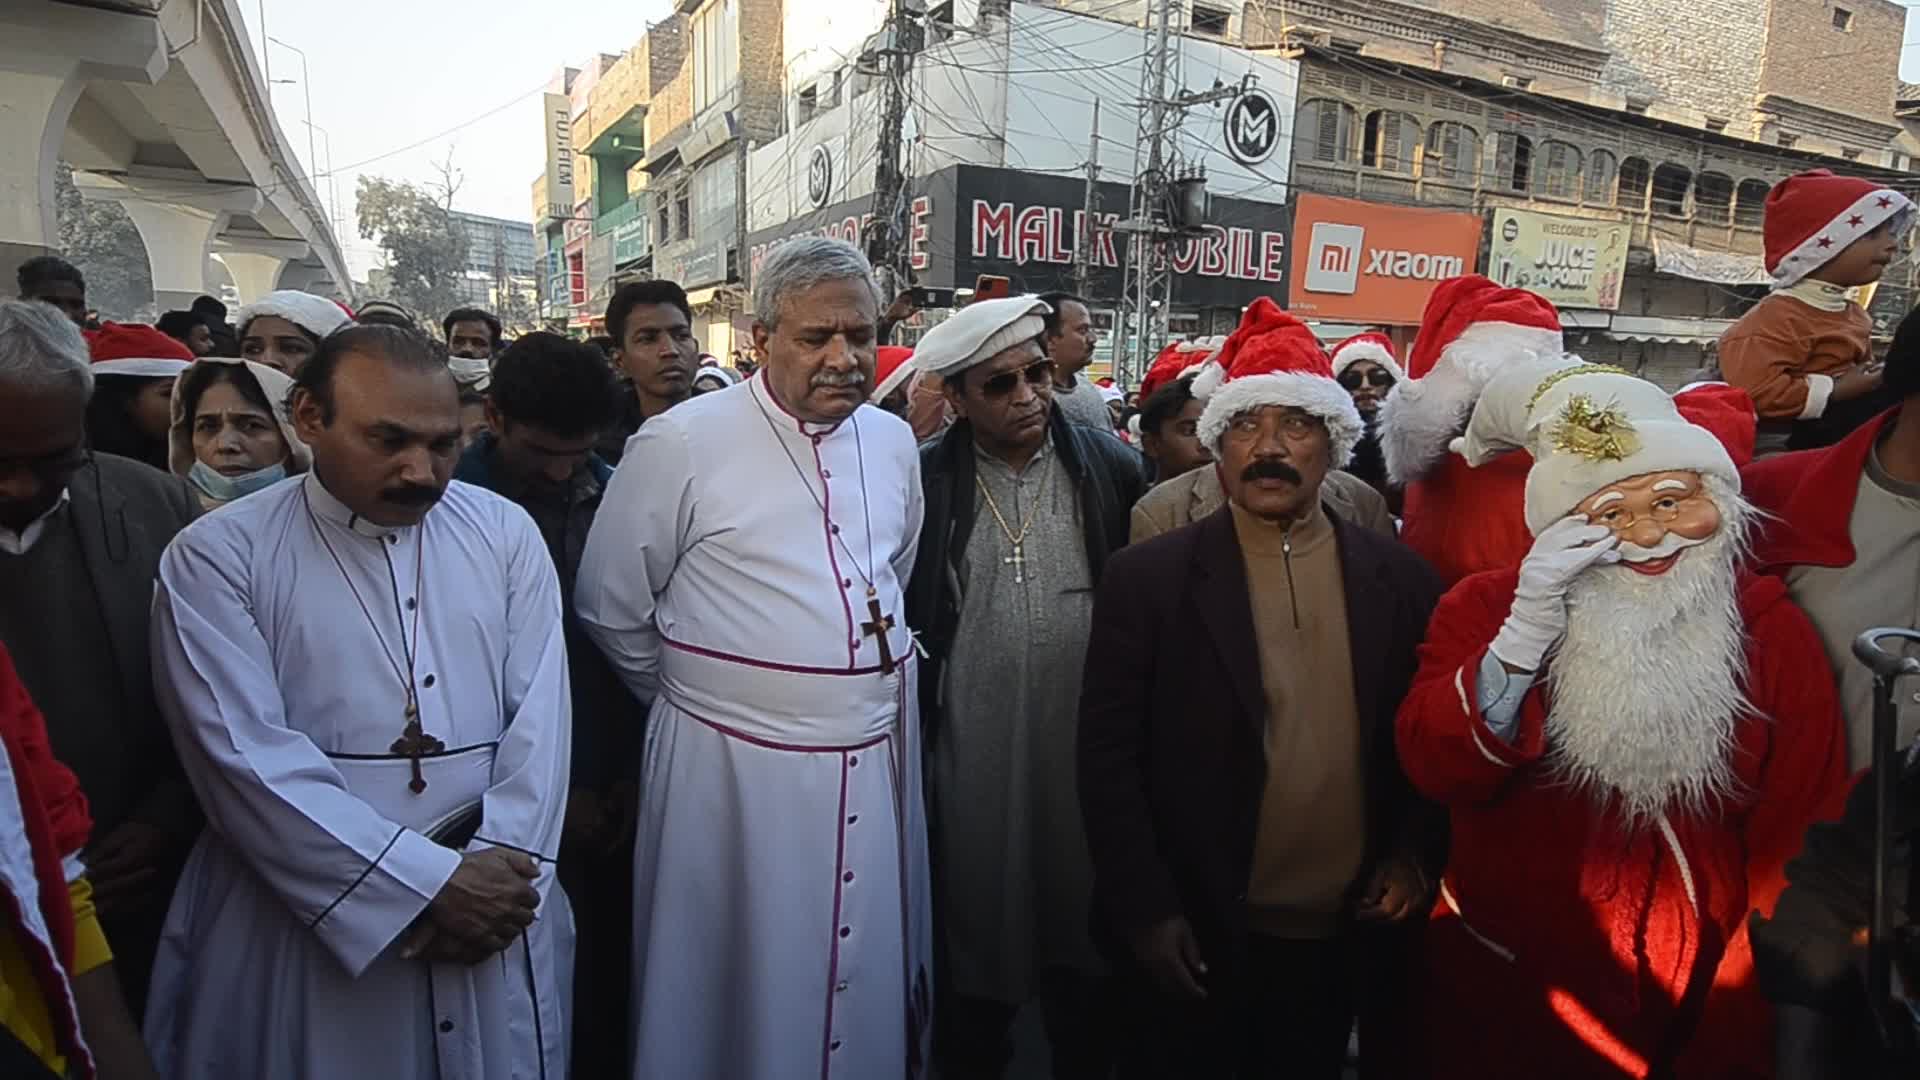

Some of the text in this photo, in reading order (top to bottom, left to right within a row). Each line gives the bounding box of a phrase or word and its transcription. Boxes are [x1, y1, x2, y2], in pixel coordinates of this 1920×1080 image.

[972, 199, 1119, 267] MALIK
[1130, 212, 1285, 282] OBILE
[1542, 223, 1599, 239] WELCOME TO
[1535, 238, 1597, 270] JUICE
